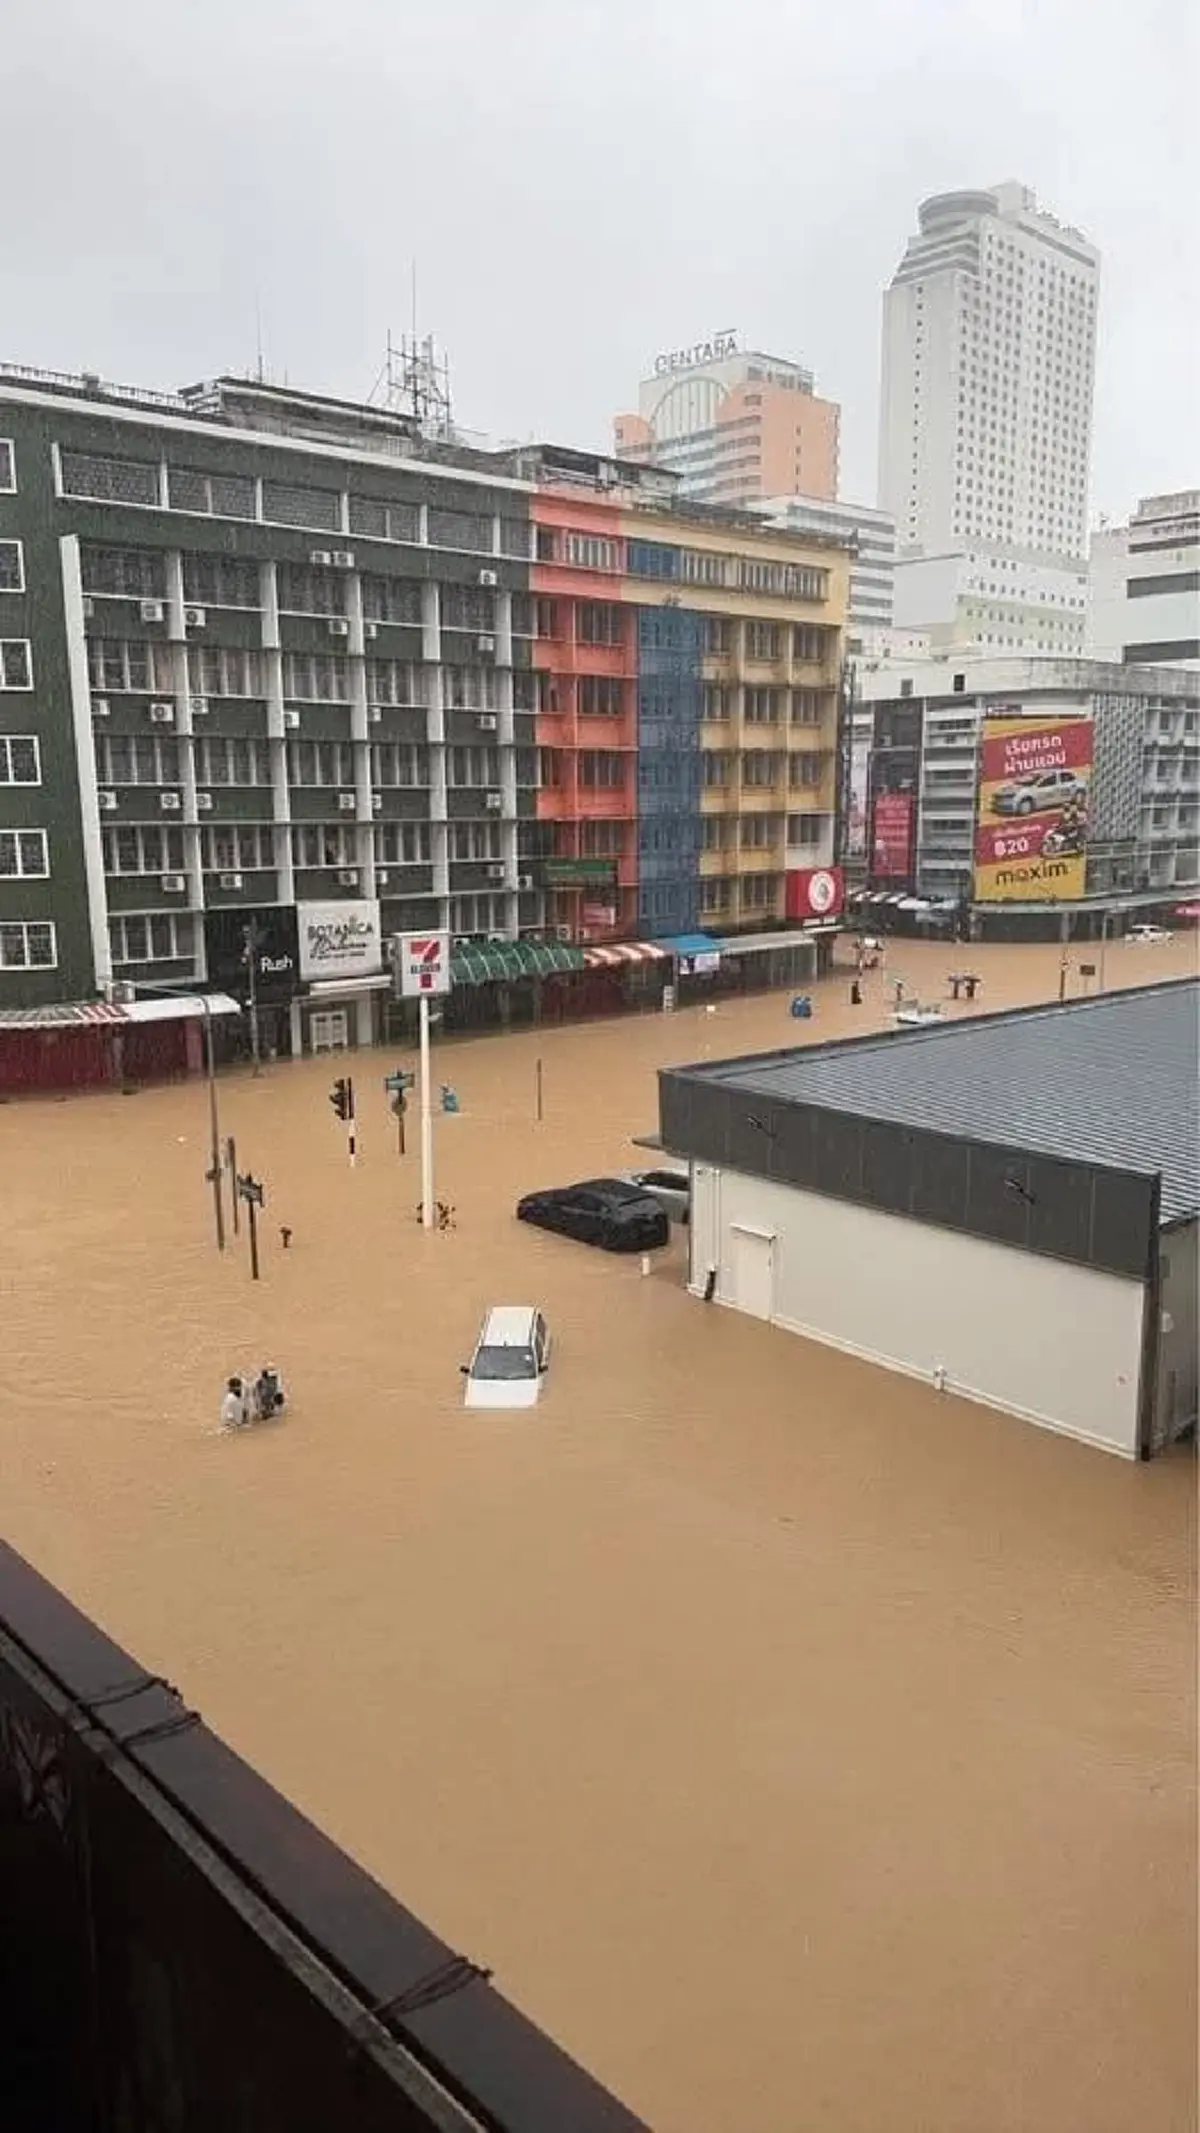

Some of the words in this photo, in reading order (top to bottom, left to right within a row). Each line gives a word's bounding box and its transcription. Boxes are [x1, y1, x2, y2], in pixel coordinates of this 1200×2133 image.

[654, 335, 736, 374] CENTARA
[996, 860, 1069, 886] maxim
[307, 922, 374, 941] BOTANICA
[261, 955, 293, 973] Rush
